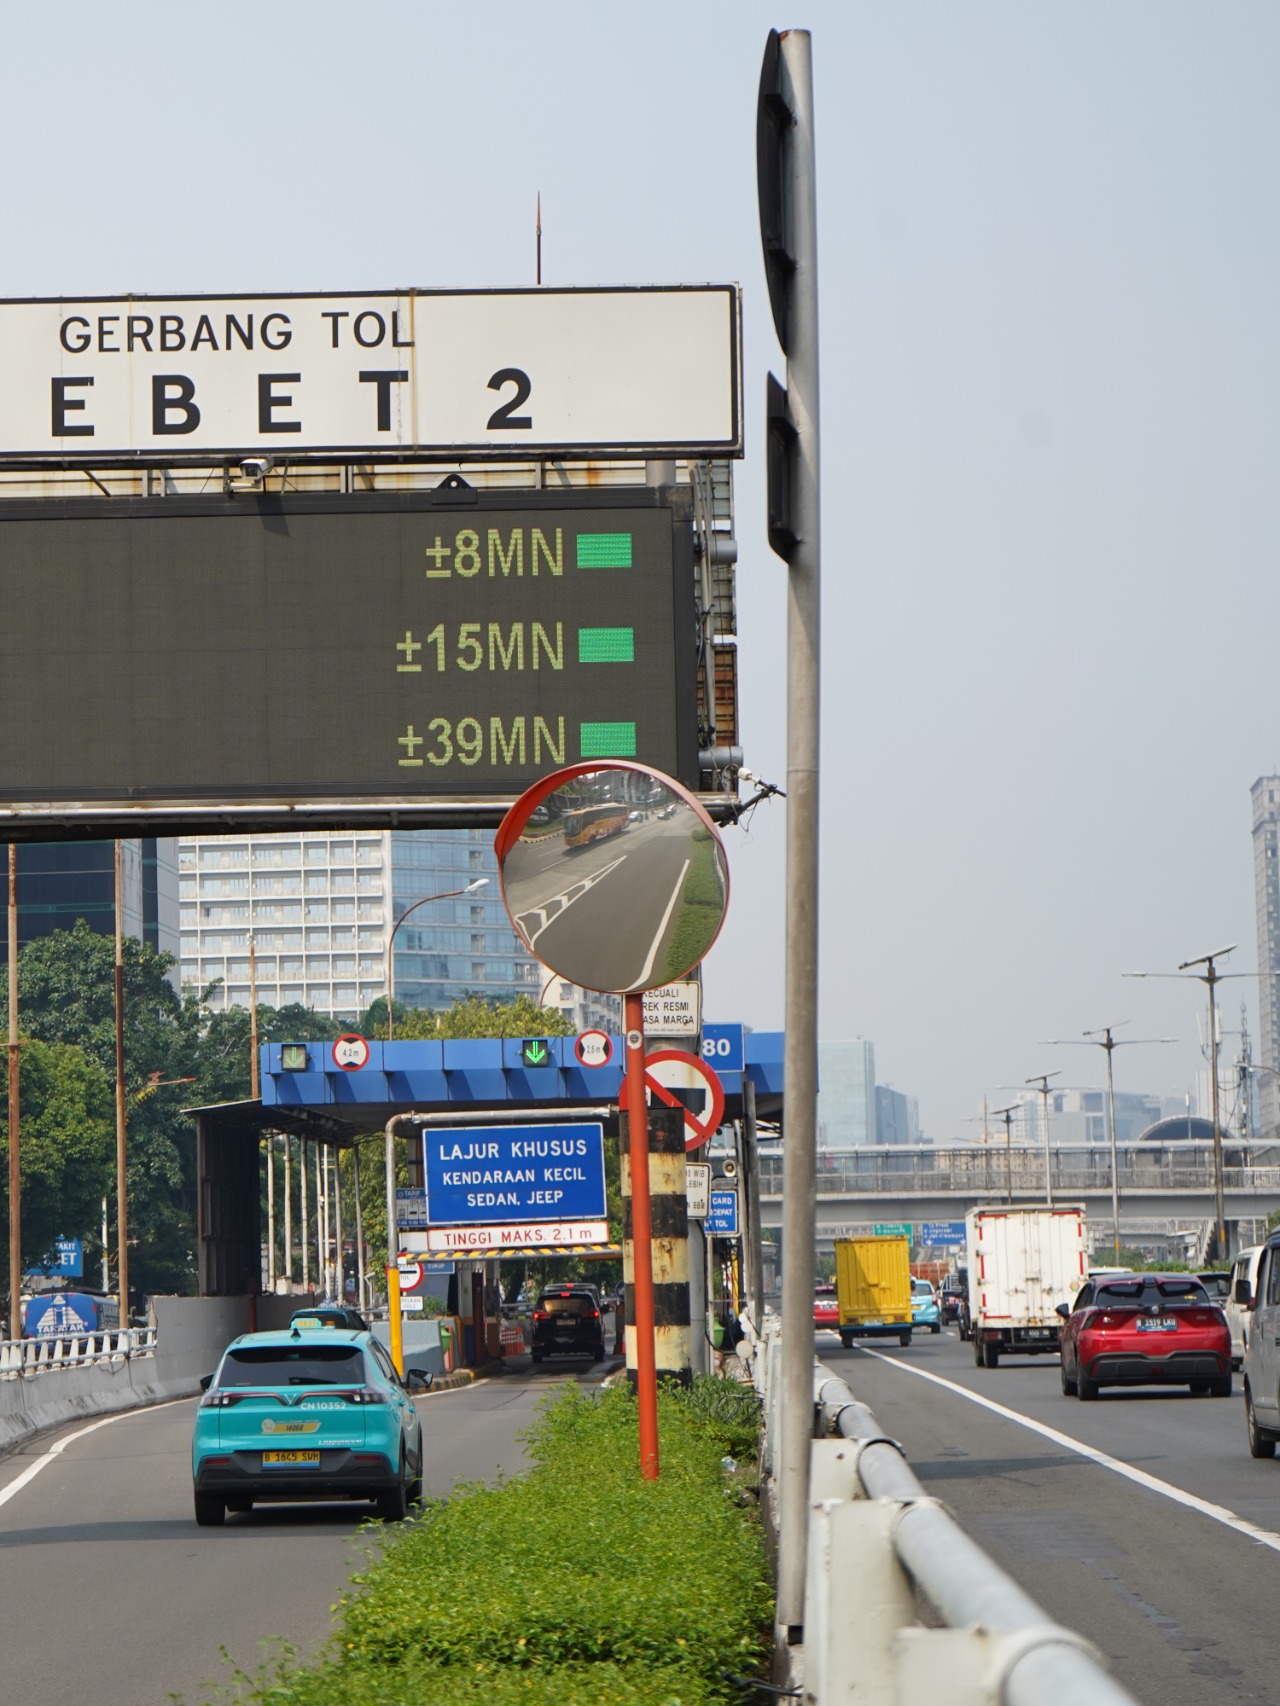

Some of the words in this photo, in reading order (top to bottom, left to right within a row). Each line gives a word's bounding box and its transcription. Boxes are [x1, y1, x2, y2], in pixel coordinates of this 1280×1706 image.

[60, 312, 293, 353] GERBANG
[321, 310, 415, 348] TOL
[487, 367, 533, 430] 2
[642, 1002, 659, 1011] REK
[663, 1002, 689, 1011] RESMI
[643, 1015, 659, 1024] ASA
[663, 1015, 694, 1025] MARGA
[703, 1039, 730, 1057] 80
[440, 1143, 499, 1160] LAJUR
[511, 1139, 587, 1157] KHUSUS
[443, 1169, 535, 1186] KENDARAAN
[544, 1168, 586, 1182] KECIL
[467, 1192, 520, 1207] SEDAN,
[526, 1190, 563, 1205] JEEP
[712, 1197, 732, 1205] CARD
[715, 1219, 728, 1227] TOL
[55, 1242, 76, 1250] AKIT
[445, 1232, 492, 1246] TINGGI
[501, 1229, 546, 1243] MAKS.
